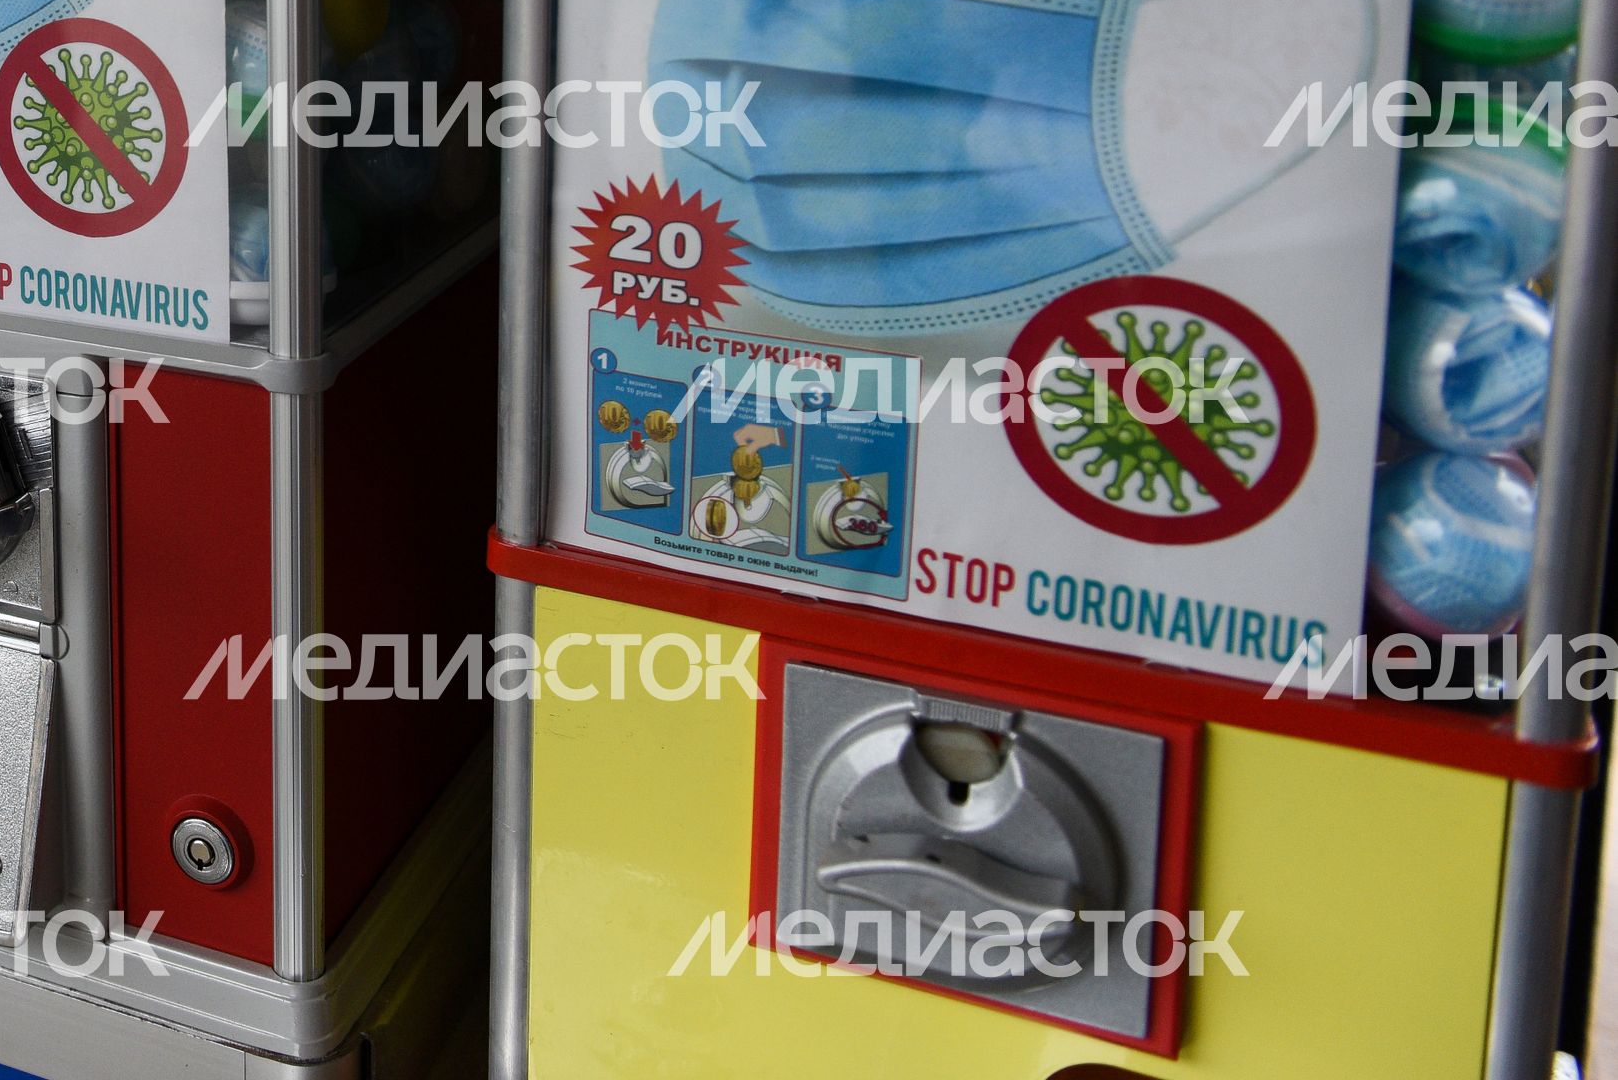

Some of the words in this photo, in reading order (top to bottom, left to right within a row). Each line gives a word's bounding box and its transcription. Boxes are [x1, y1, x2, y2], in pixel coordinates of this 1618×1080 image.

[609, 214, 703, 269] 20
[20, 267, 210, 332] CORONAVIRUS
[612, 271, 700, 307] РУБ.
[597, 353, 608, 369] 1
[655, 327, 843, 373] ИНСТРУКЦИЯ
[809, 386, 825, 405] 3
[654, 536, 702, 555] Возьмите
[705, 548, 735, 562] товар
[747, 555, 771, 567] окне
[915, 547, 1015, 608] STOP
[1027, 569, 1330, 670] CORONAVIRUS
